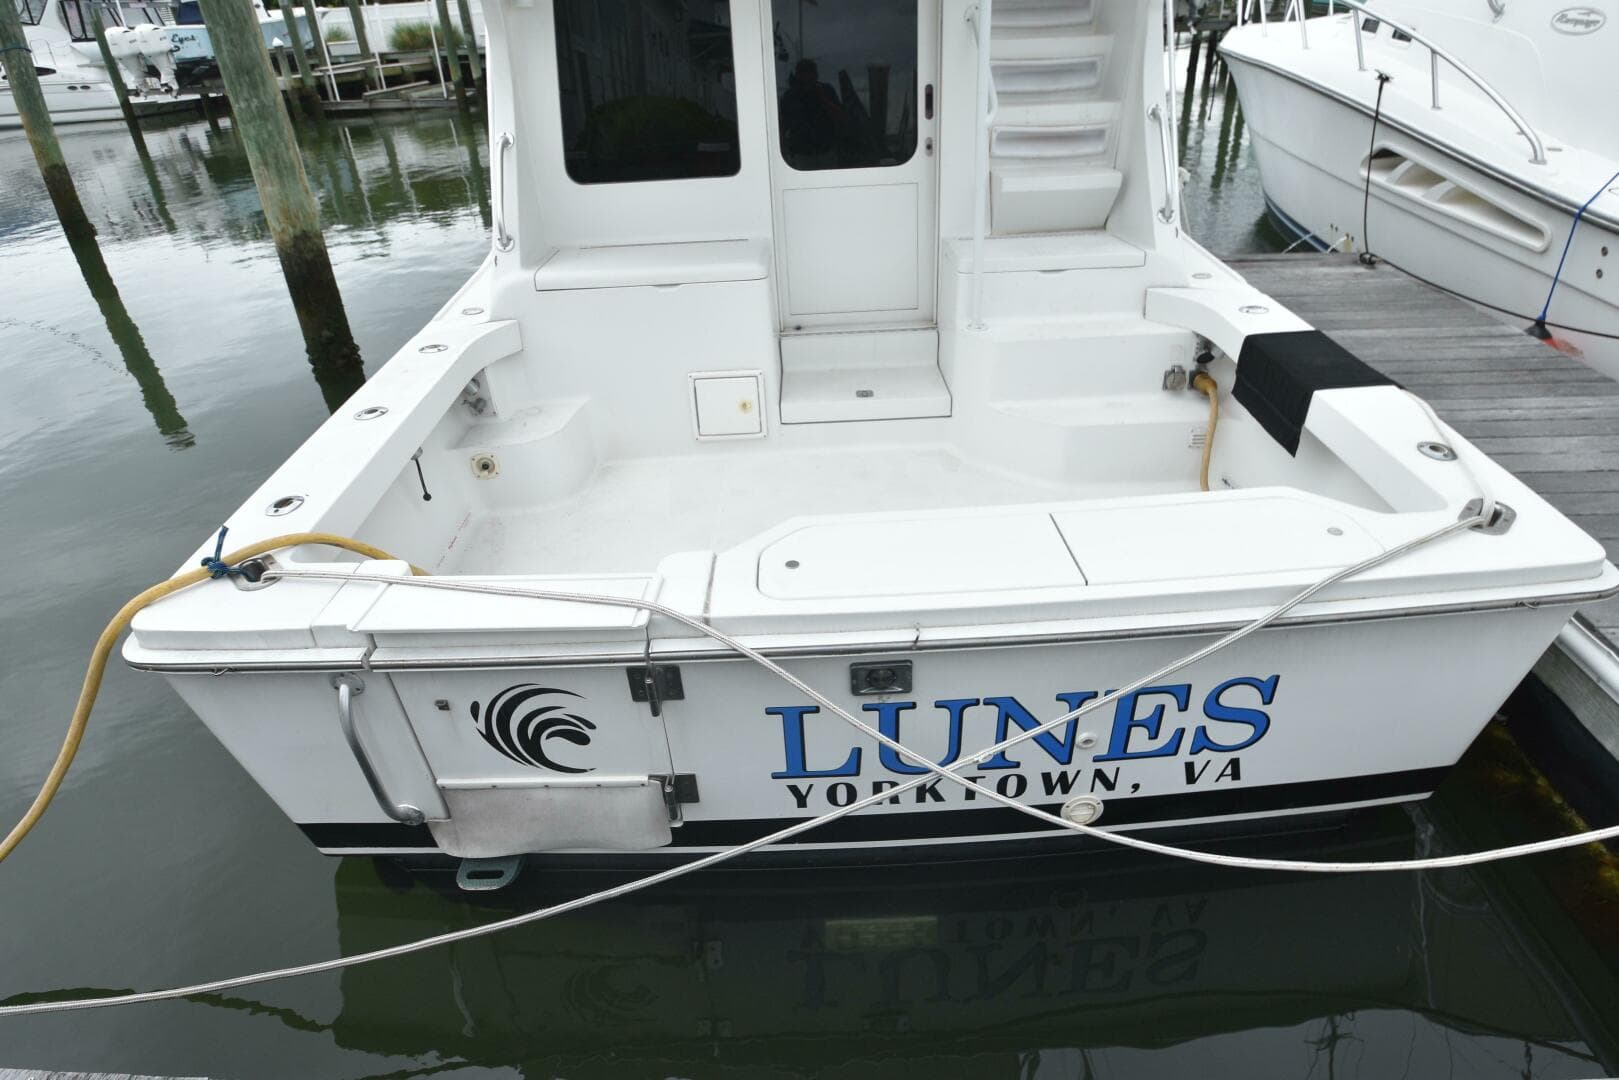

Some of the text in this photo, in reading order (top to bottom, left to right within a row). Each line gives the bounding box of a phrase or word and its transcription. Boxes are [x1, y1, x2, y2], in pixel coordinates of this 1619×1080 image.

[765, 674, 1281, 780] LUNES
[785, 756, 1242, 809] YORKTOWN, VA
